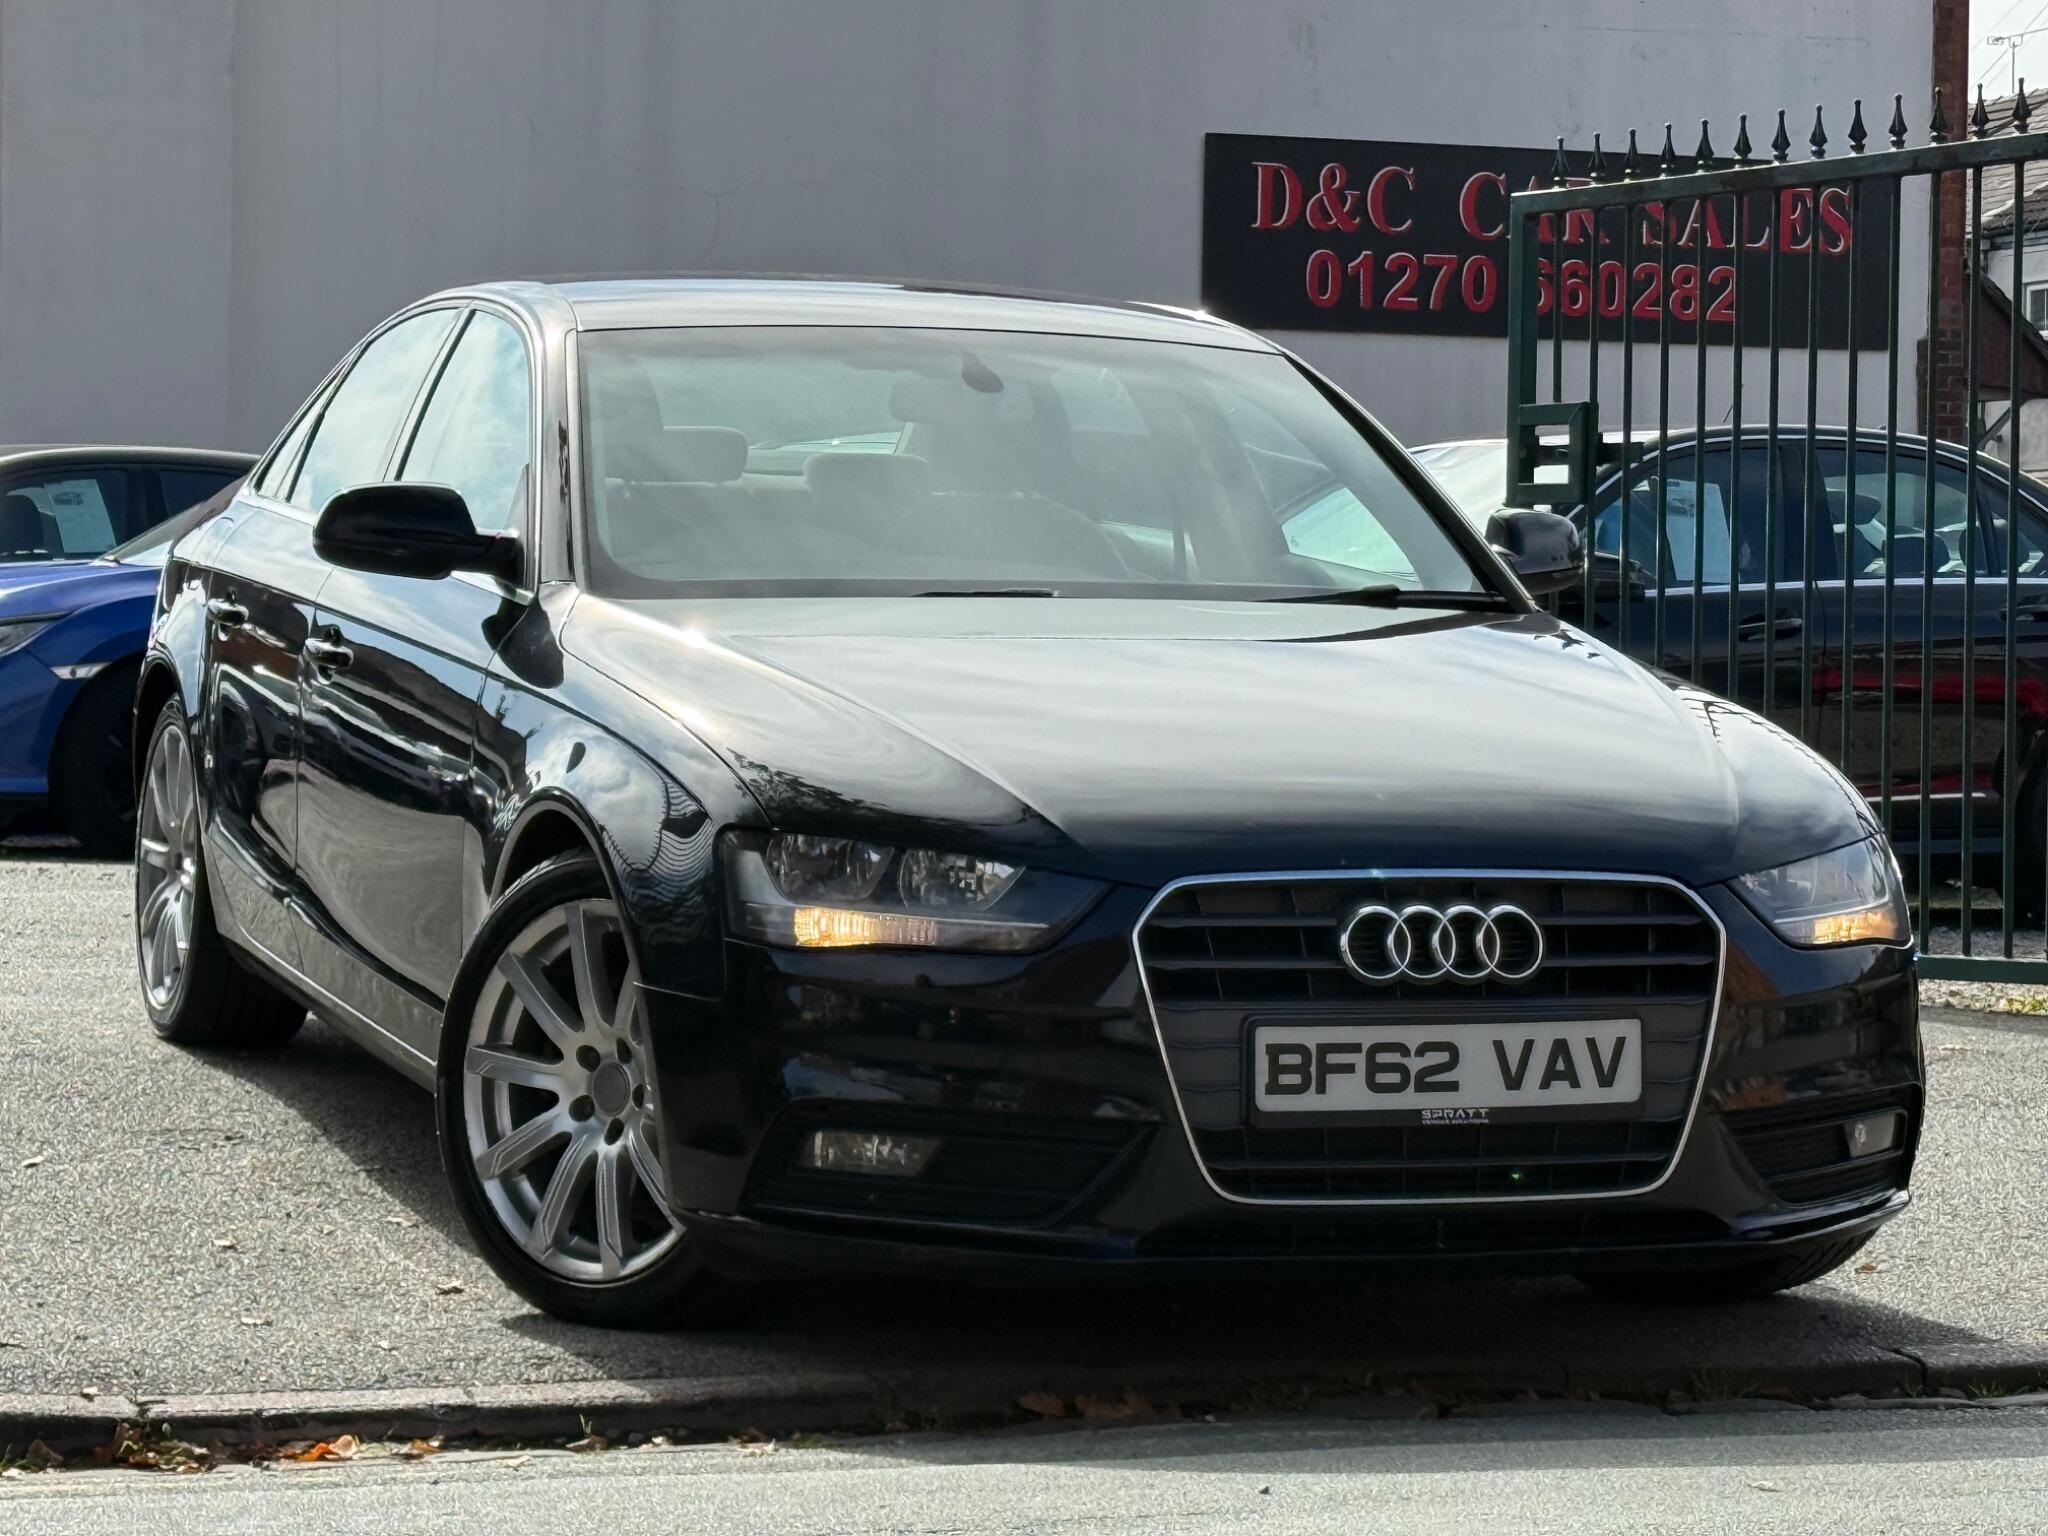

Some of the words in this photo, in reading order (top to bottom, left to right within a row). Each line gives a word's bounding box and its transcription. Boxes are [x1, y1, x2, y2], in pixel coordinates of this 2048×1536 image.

[1251, 162, 1416, 235] D&C
[1642, 184, 1852, 255] SALES
[1306, 249, 1498, 313] 01270
[1534, 257, 1736, 321] 660282
[1265, 1041, 1460, 1095] BF62
[1492, 1036, 1627, 1091] VAV
[1421, 1108, 1489, 1119] SPRATT
